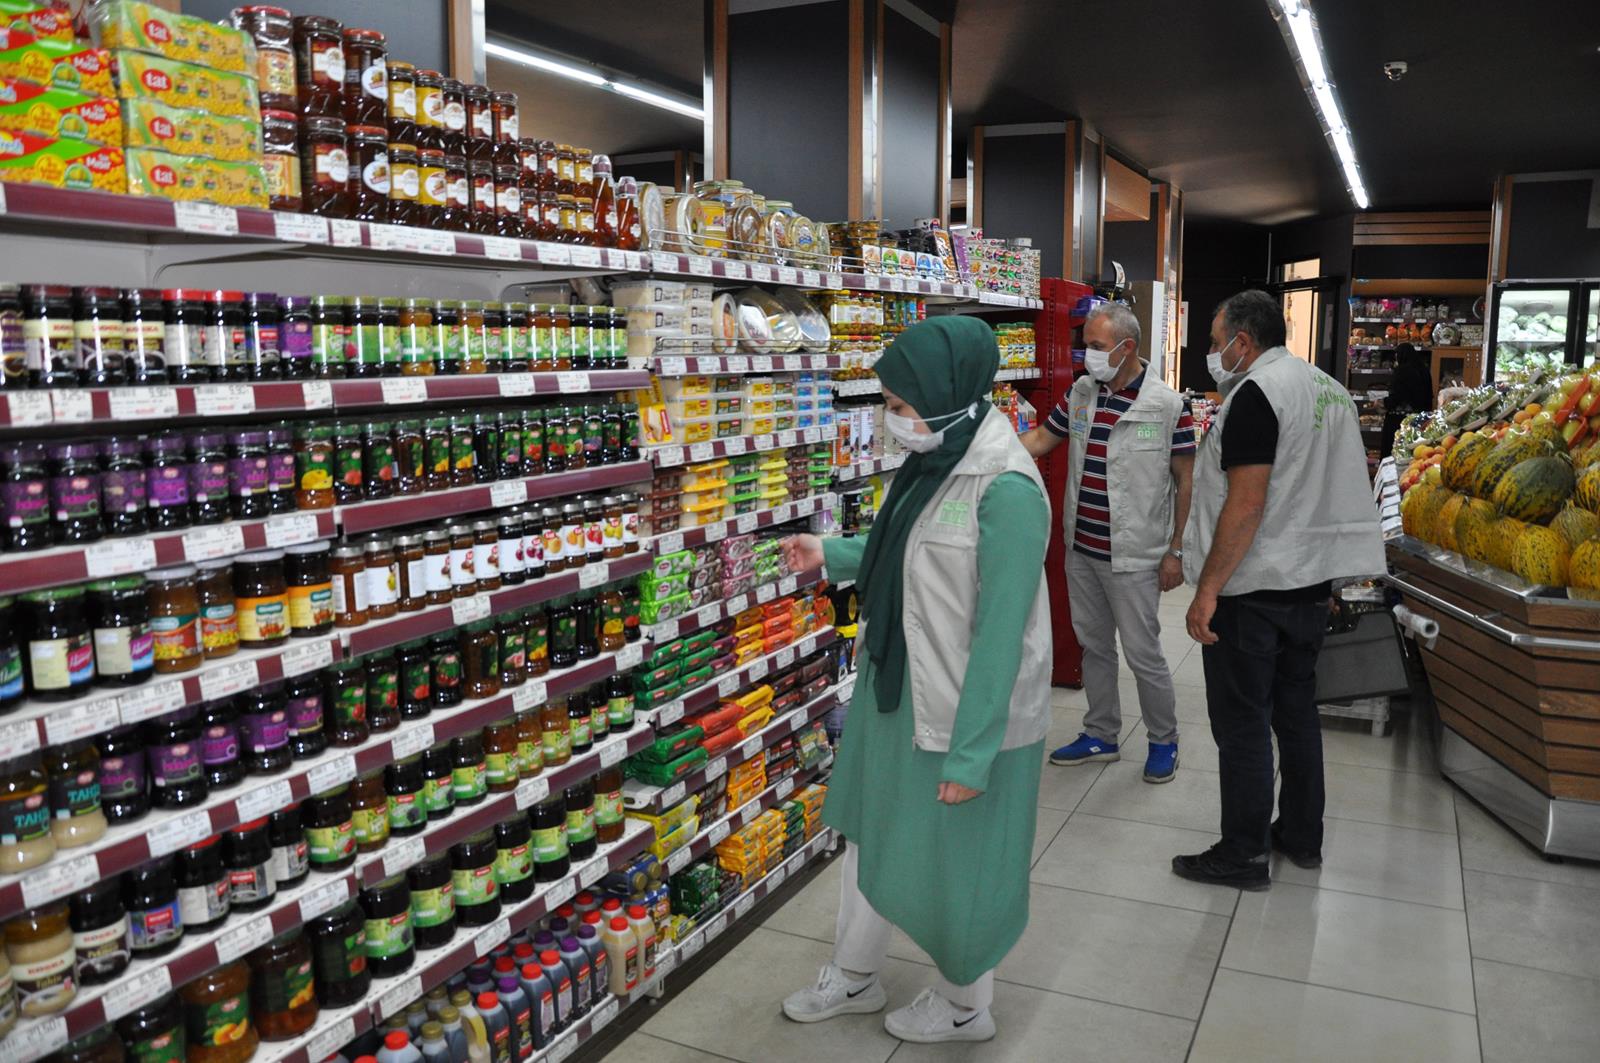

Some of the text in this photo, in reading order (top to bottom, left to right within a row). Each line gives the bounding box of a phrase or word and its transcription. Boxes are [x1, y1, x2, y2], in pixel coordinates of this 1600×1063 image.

[148, 22, 171, 41] tat
[145, 72, 170, 90] tat
[153, 119, 175, 137] tat
[153, 167, 175, 186] tat
